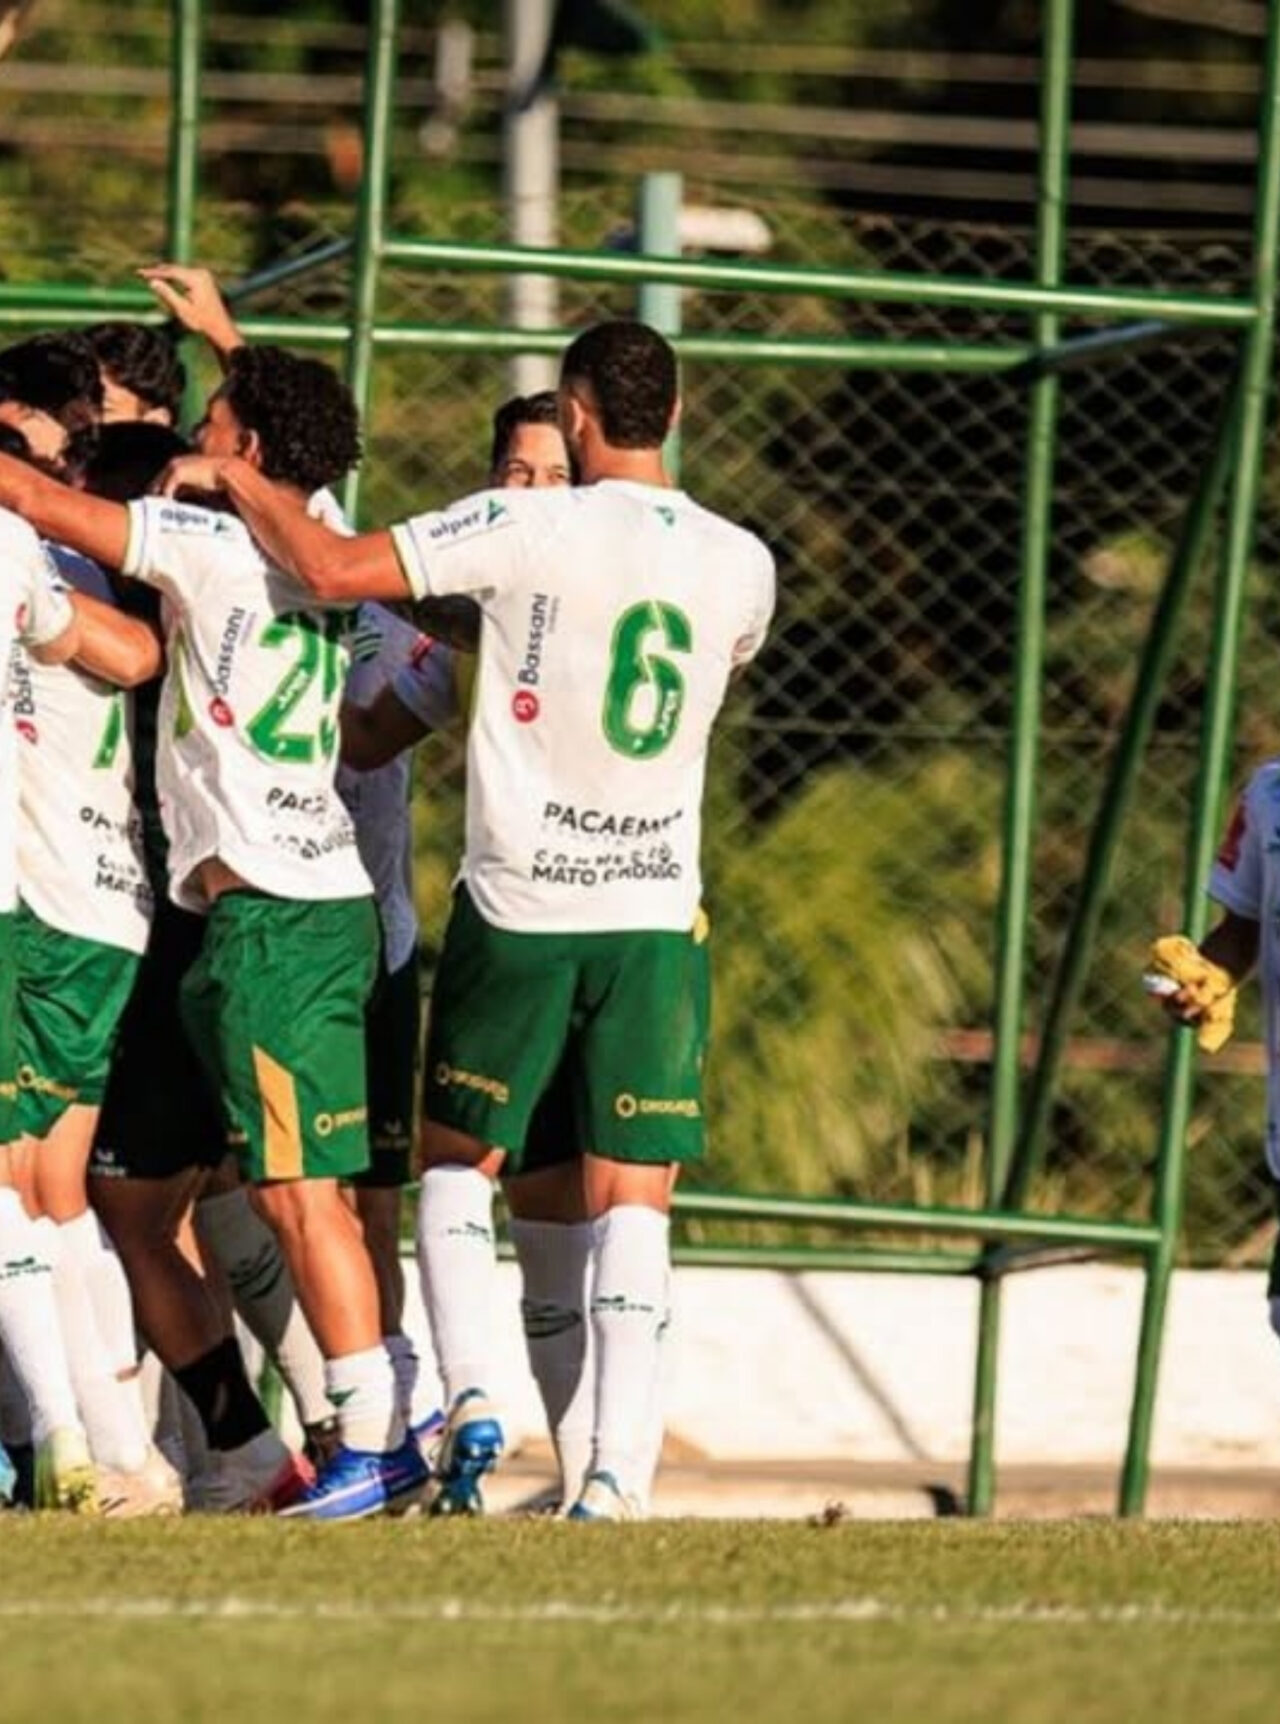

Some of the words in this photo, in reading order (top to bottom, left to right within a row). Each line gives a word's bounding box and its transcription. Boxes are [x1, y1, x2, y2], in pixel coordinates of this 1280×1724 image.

[517, 593, 548, 685] Bassani
[601, 599, 693, 761] 6
[531, 864, 598, 887] MATO
